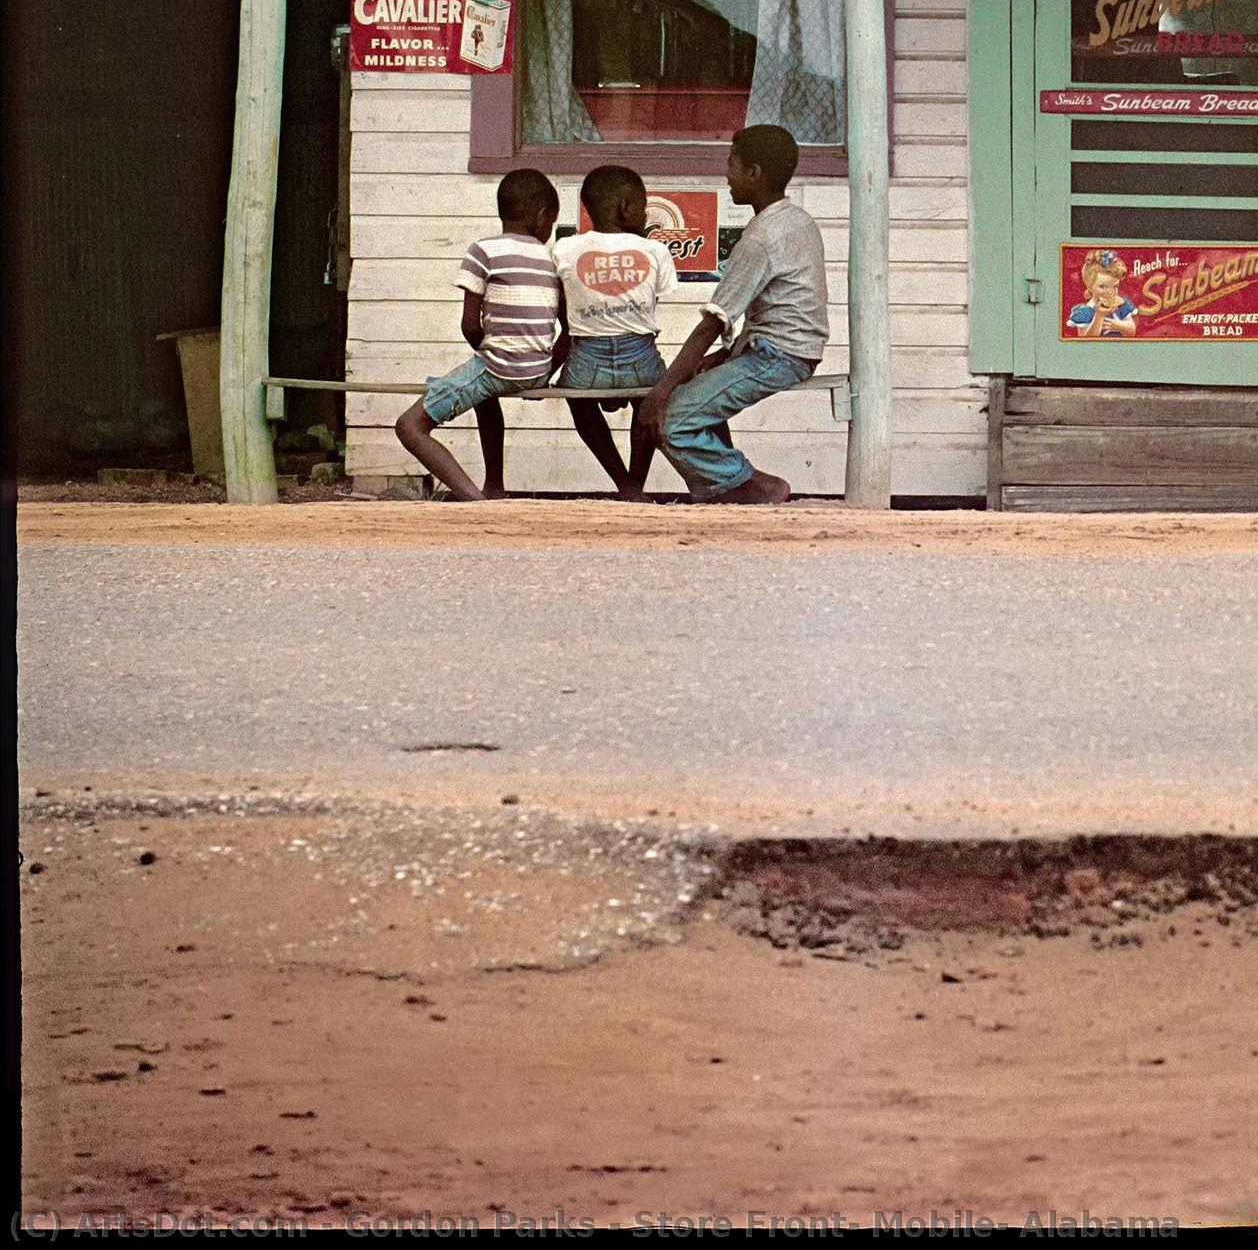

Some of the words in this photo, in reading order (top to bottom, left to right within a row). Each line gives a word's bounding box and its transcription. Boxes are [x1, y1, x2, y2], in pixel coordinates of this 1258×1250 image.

[1156, 31, 1246, 54] BREAD
[364, 54, 447, 68] MILDNESS
[1054, 93, 1093, 106] Smith's
[1101, 93, 1191, 111] Sunbeam
[594, 254, 635, 269] RED
[1133, 254, 1162, 277] Reach
[584, 268, 646, 287] HEART
[1203, 325, 1243, 336] BREAD
